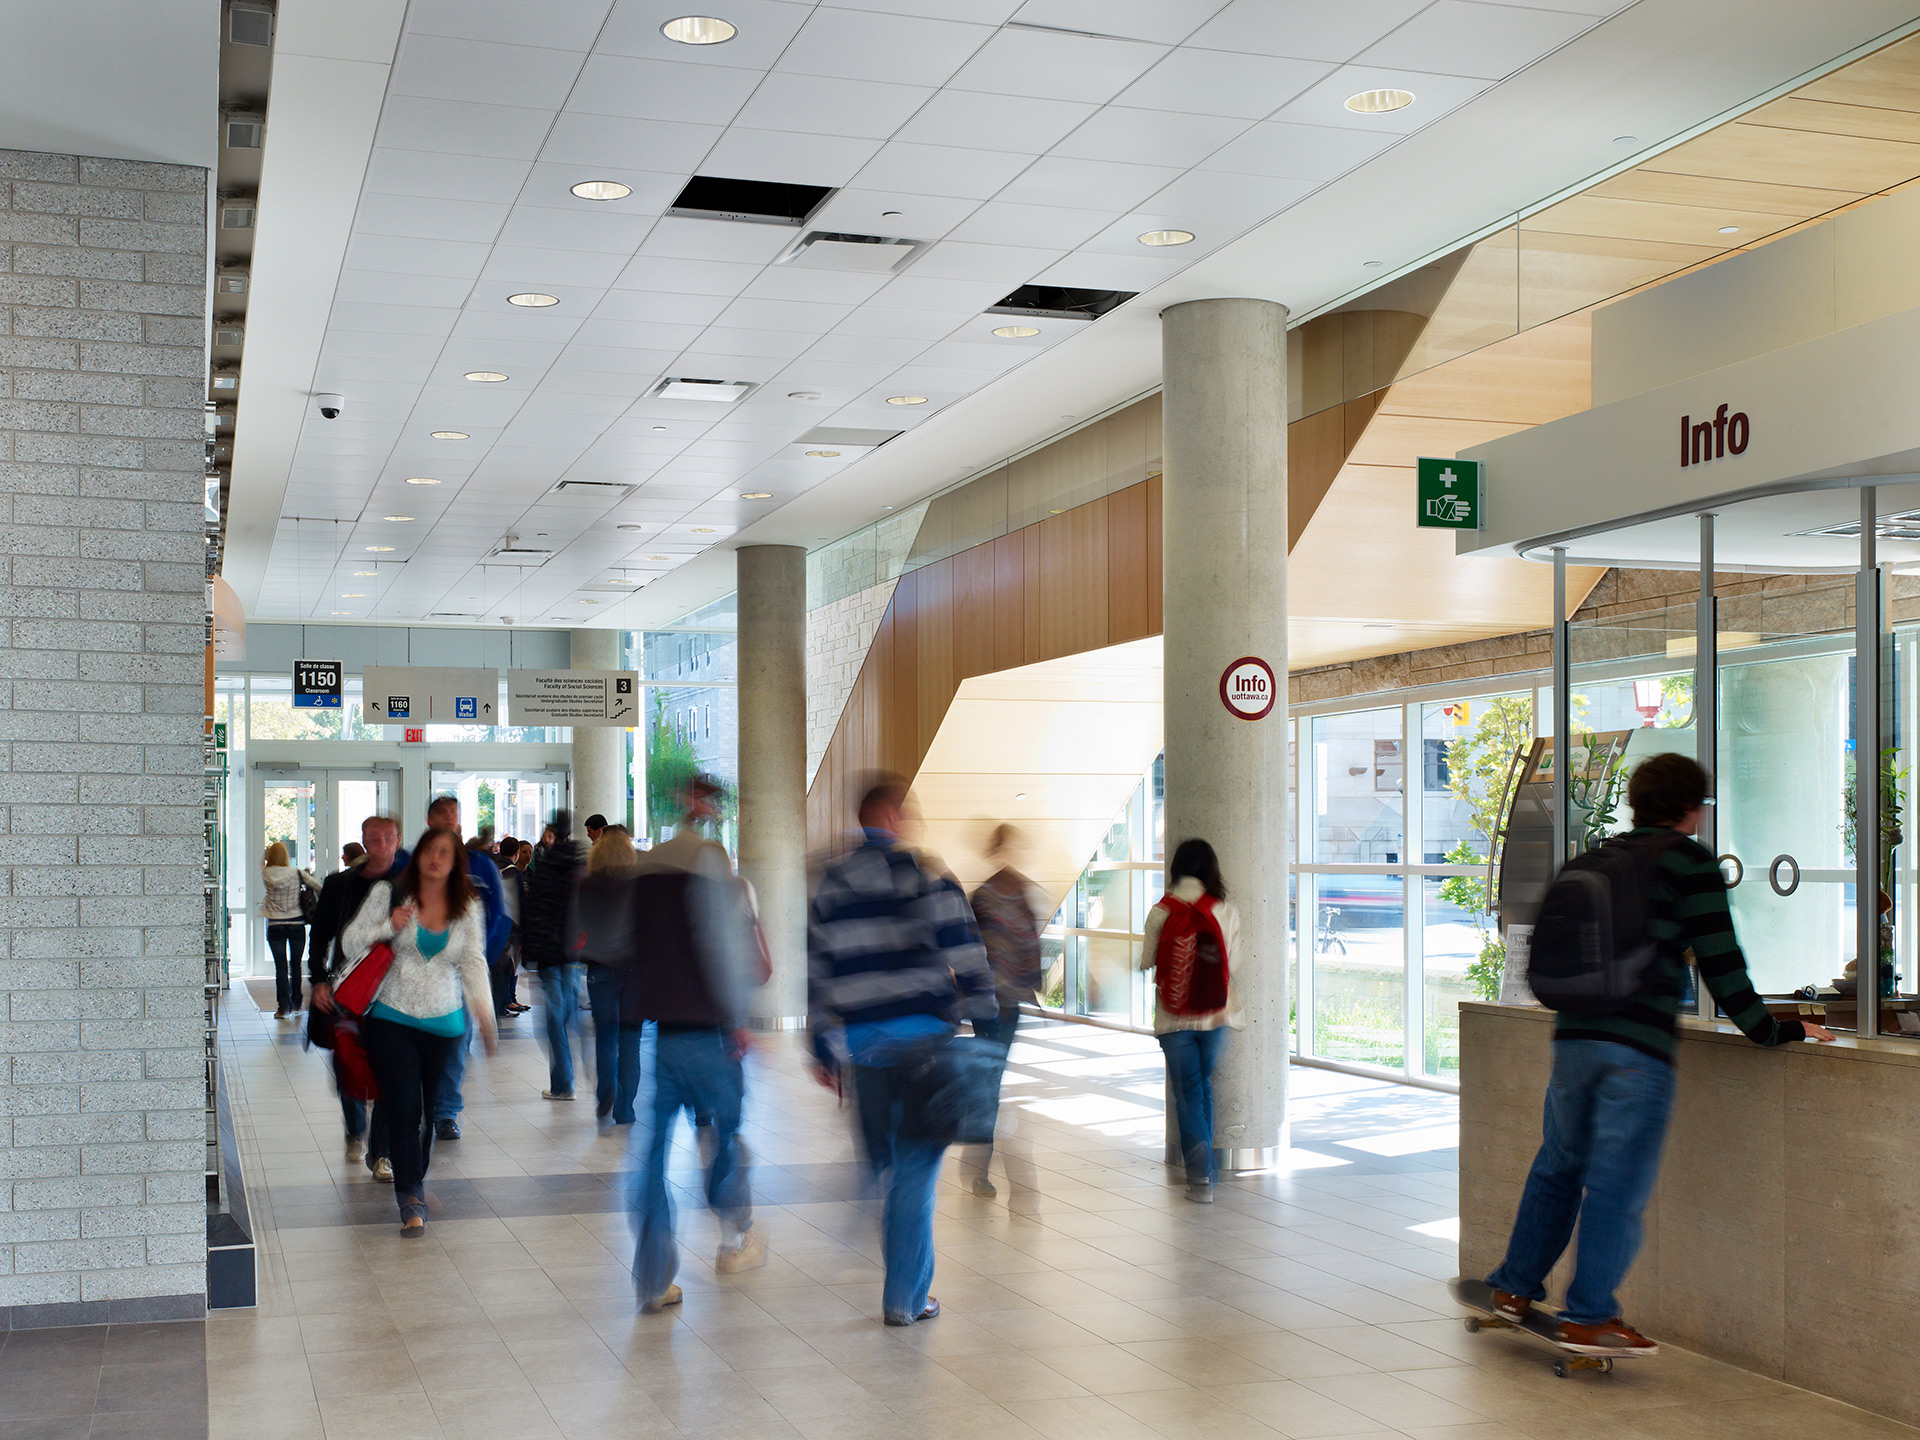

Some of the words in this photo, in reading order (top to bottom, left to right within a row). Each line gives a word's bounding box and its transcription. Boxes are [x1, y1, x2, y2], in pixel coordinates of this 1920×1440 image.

[1681, 403, 1749, 467] Info
[300, 671, 336, 686] 1150
[1236, 674, 1266, 692] Info
[620, 681, 628, 691] 3
[390, 700, 408, 708] 1160
[406, 729, 423, 742] EXIT
